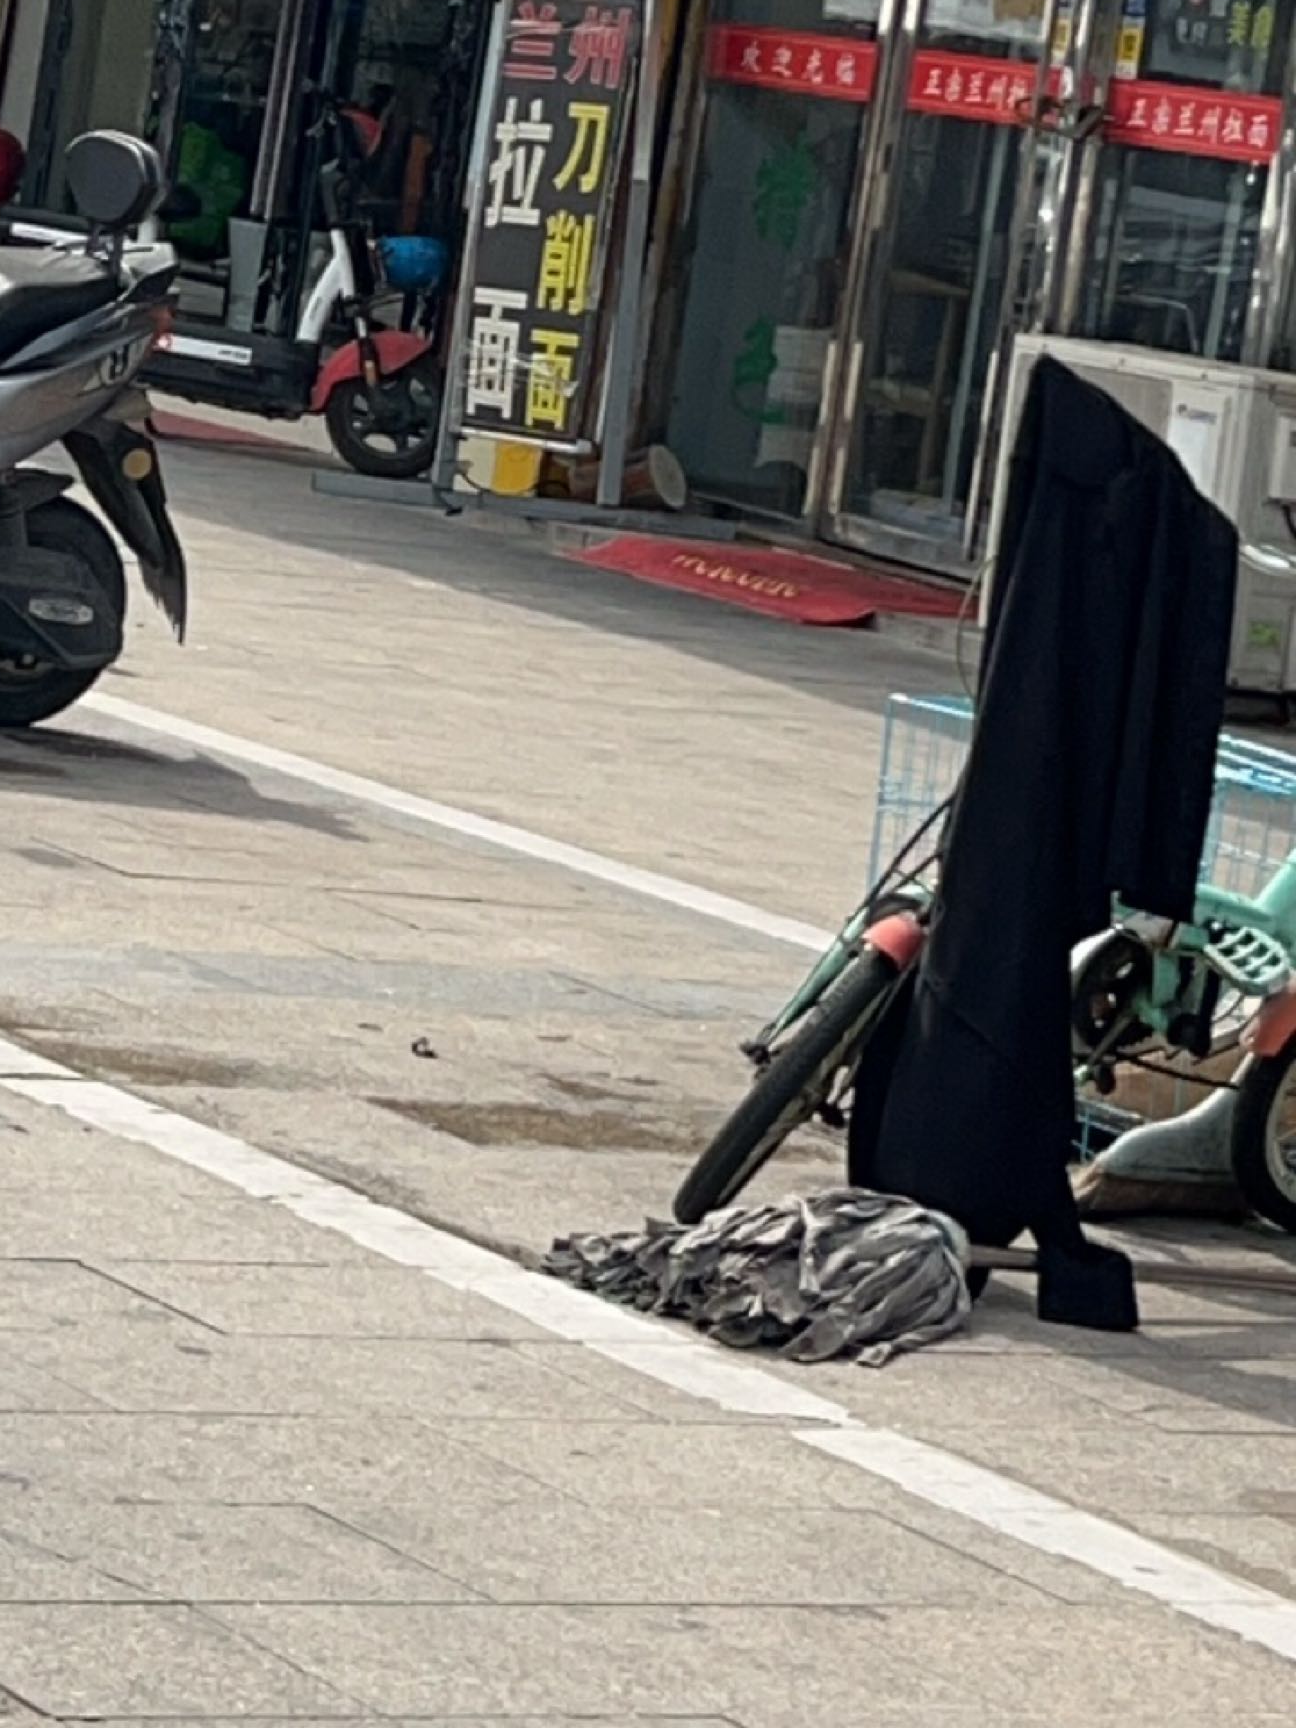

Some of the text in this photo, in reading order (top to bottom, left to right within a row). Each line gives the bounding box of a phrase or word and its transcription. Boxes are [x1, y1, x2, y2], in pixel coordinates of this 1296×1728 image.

[503, 0, 634, 89] 兰州
[740, 40, 856, 86] 欢迎光临
[922, 65, 1029, 112] 正宗兰州拉
[1125, 95, 1270, 149] 正宗兰州拉面
[465, 97, 554, 421] 拉面
[524, 101, 611, 432] 刀削面
